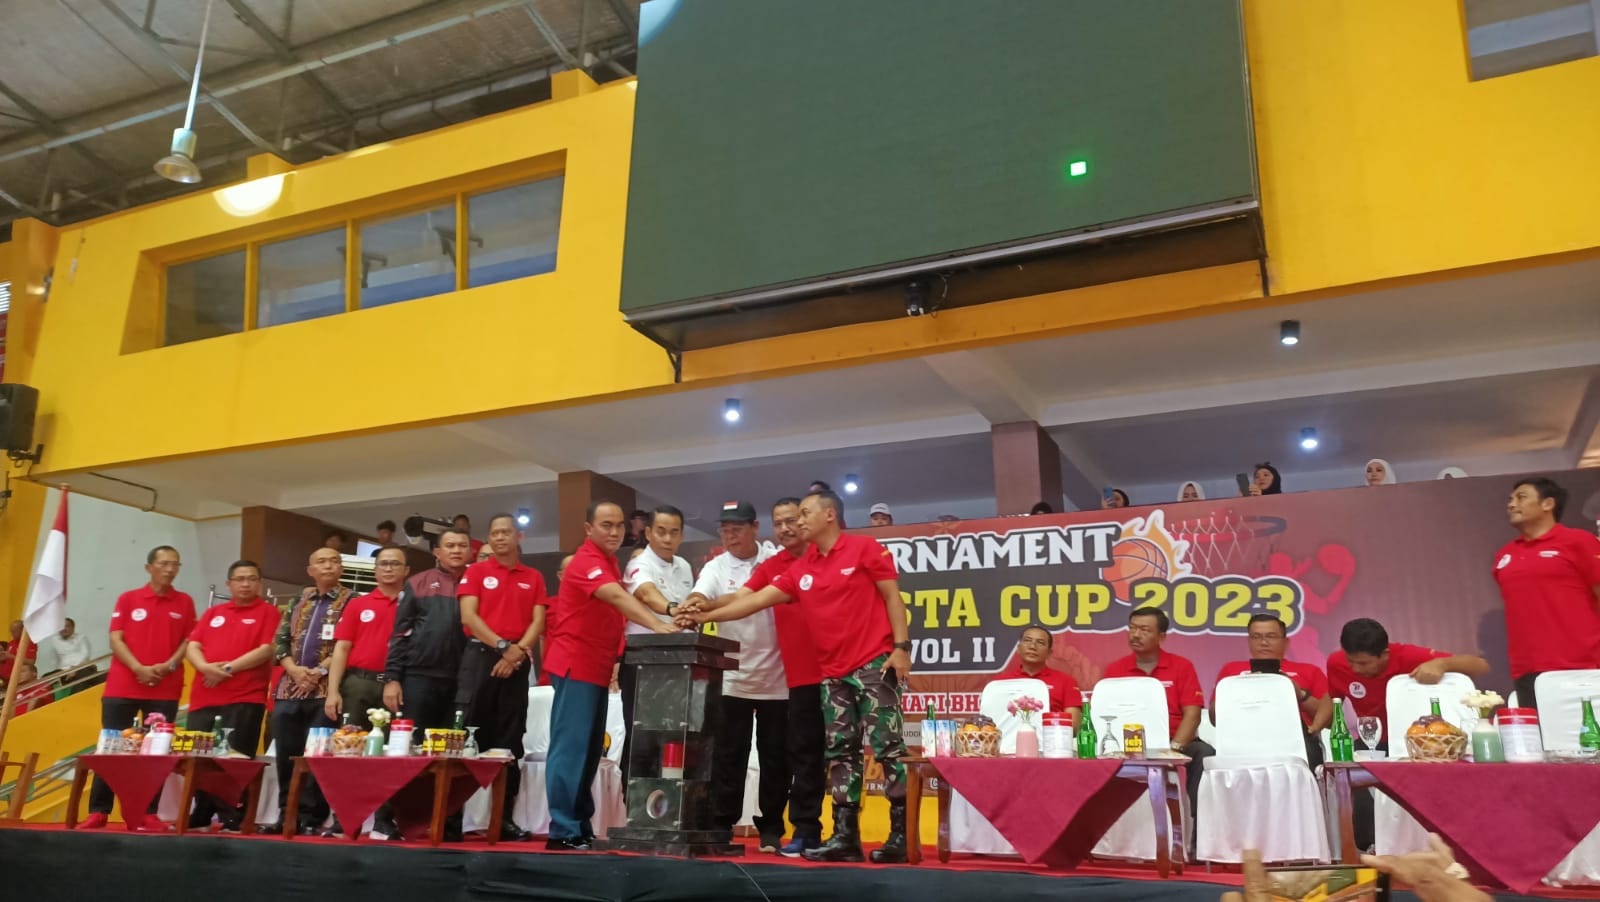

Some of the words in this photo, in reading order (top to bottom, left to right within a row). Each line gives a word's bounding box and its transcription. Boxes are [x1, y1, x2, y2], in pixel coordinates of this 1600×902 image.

[881, 527, 1116, 574] RNAMENT
[1001, 584, 1110, 627] CUP
[1134, 582, 1295, 628] 2023
[973, 637, 995, 662] II
